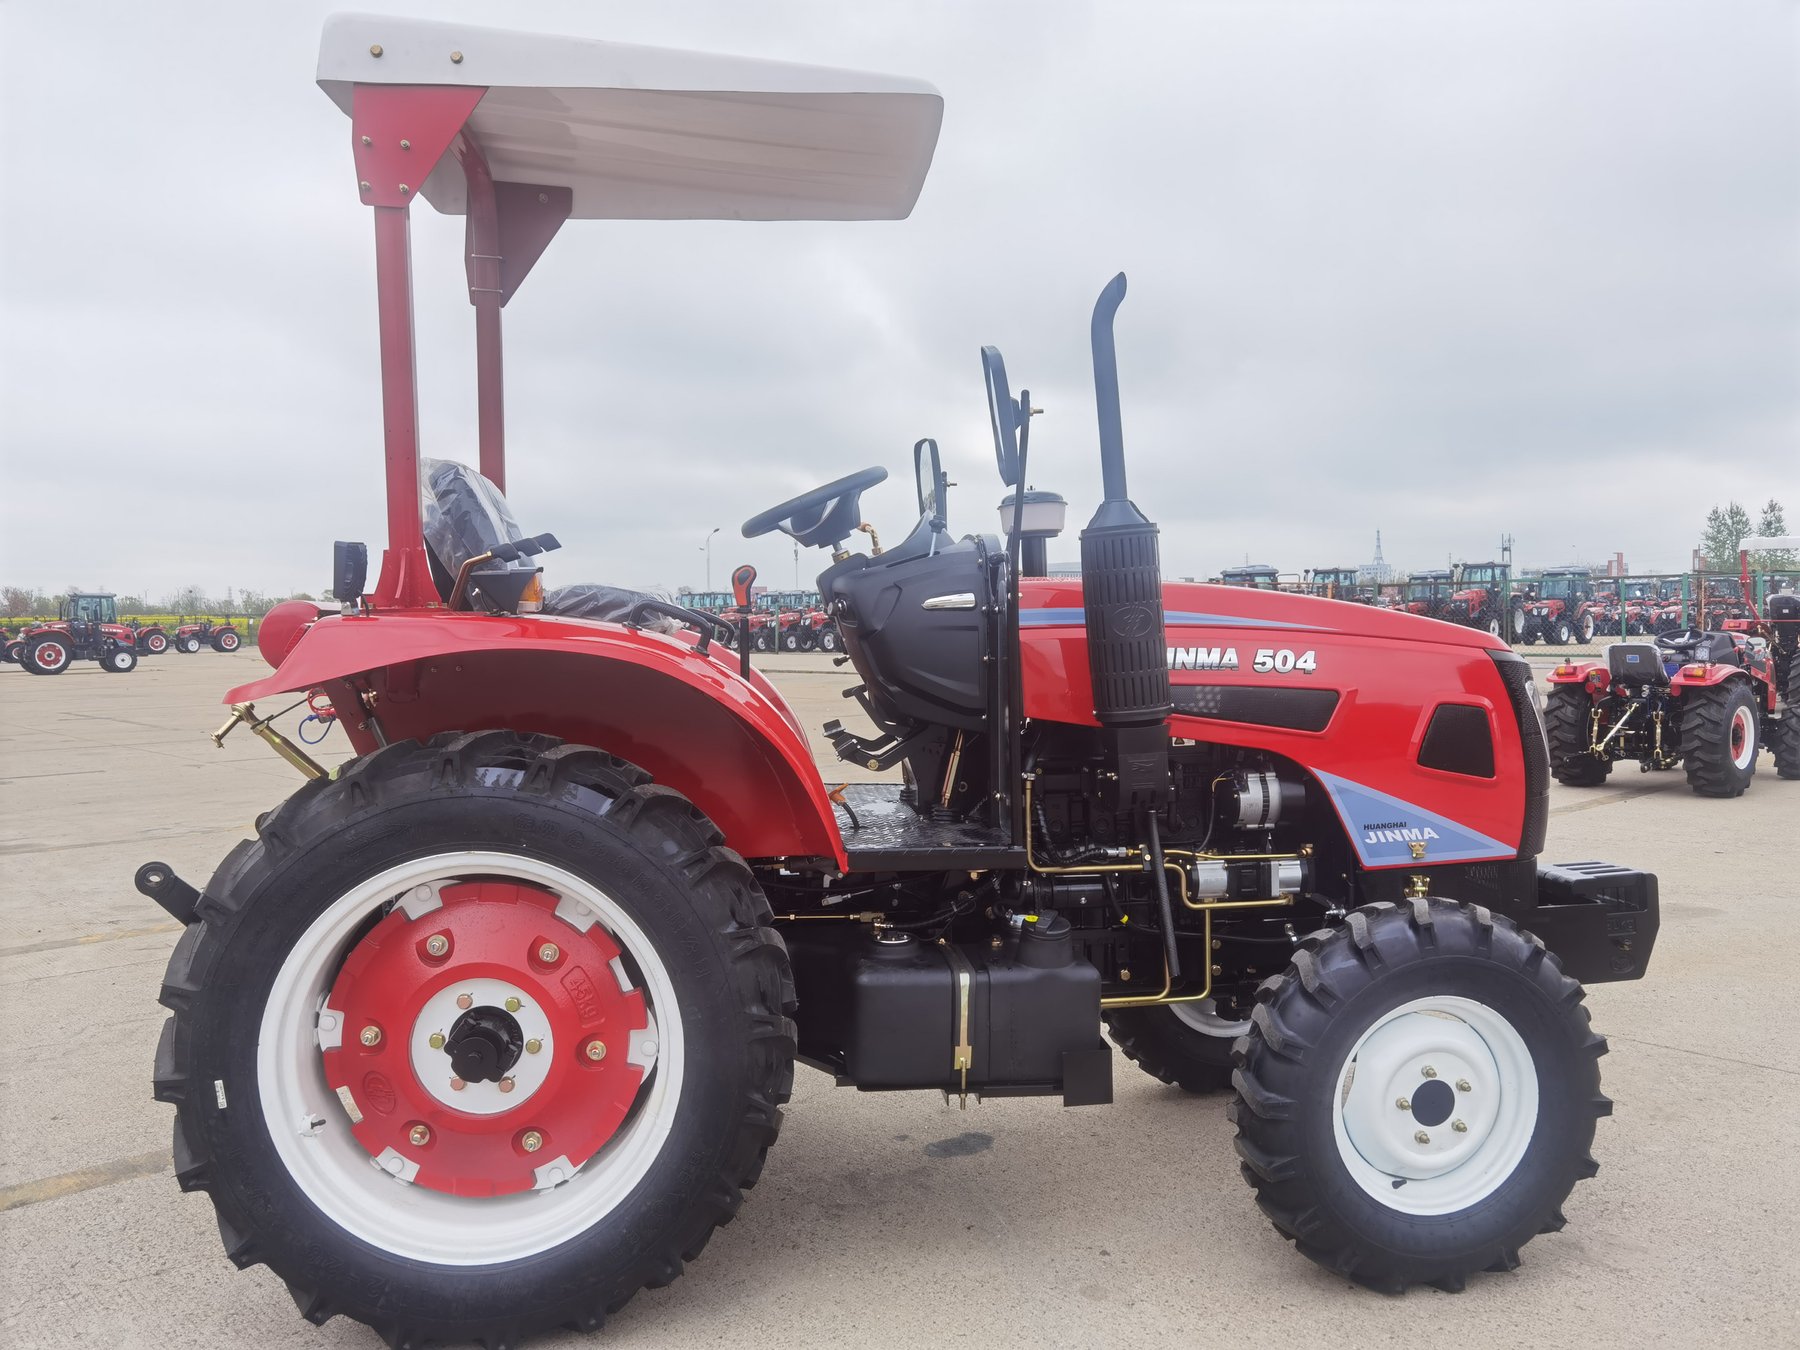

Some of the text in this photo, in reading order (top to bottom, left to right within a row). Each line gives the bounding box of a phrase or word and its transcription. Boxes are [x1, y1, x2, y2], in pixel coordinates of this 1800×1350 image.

[1166, 647, 1317, 674] INMA 504
[1363, 821, 1407, 831] HUANGHAI
[1364, 827, 1440, 844] JINMA
